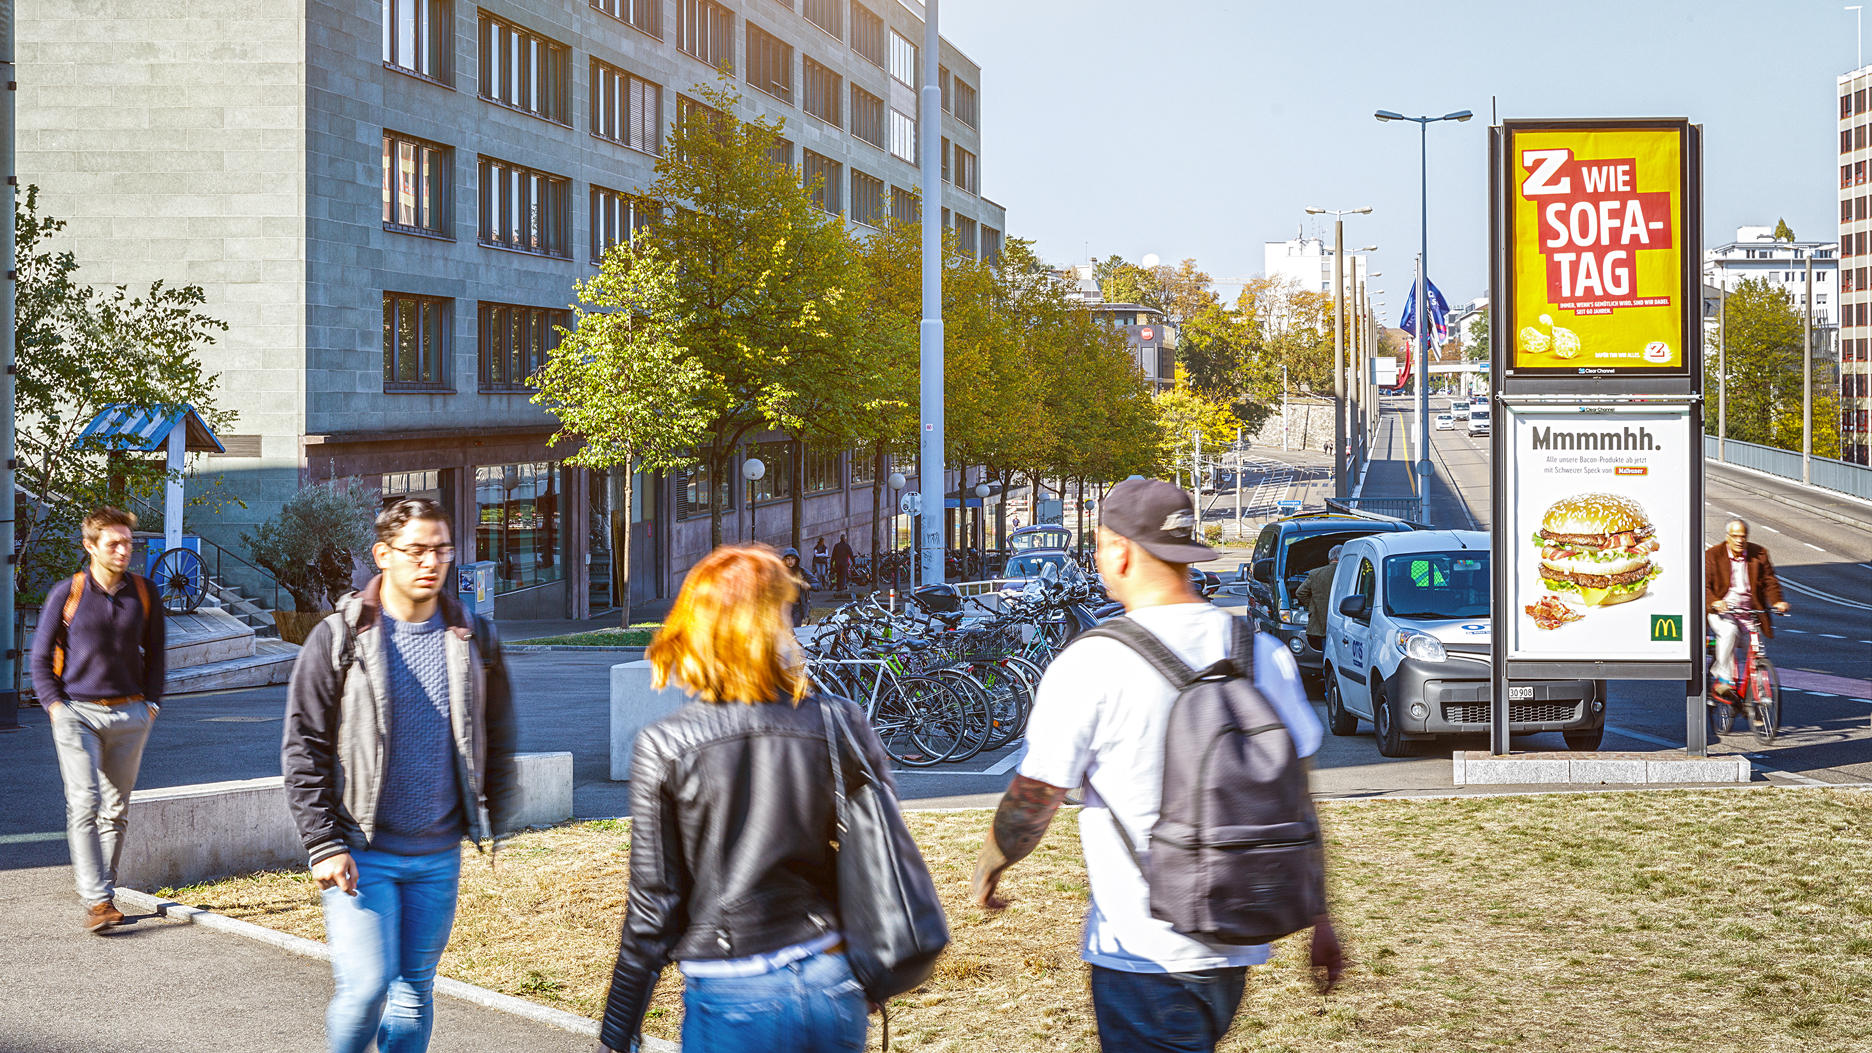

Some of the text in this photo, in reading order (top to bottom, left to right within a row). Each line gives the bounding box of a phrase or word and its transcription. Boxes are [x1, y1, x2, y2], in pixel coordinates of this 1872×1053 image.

[1523, 149, 1631, 196] Z WIE
[1545, 199, 1664, 248] SOFA-
[1553, 250, 1630, 297] TAG
[1532, 426, 1661, 451] Mmmmhh.
[1584, 466, 1601, 475] Speck
[1634, 456, 1647, 465] jetzt
